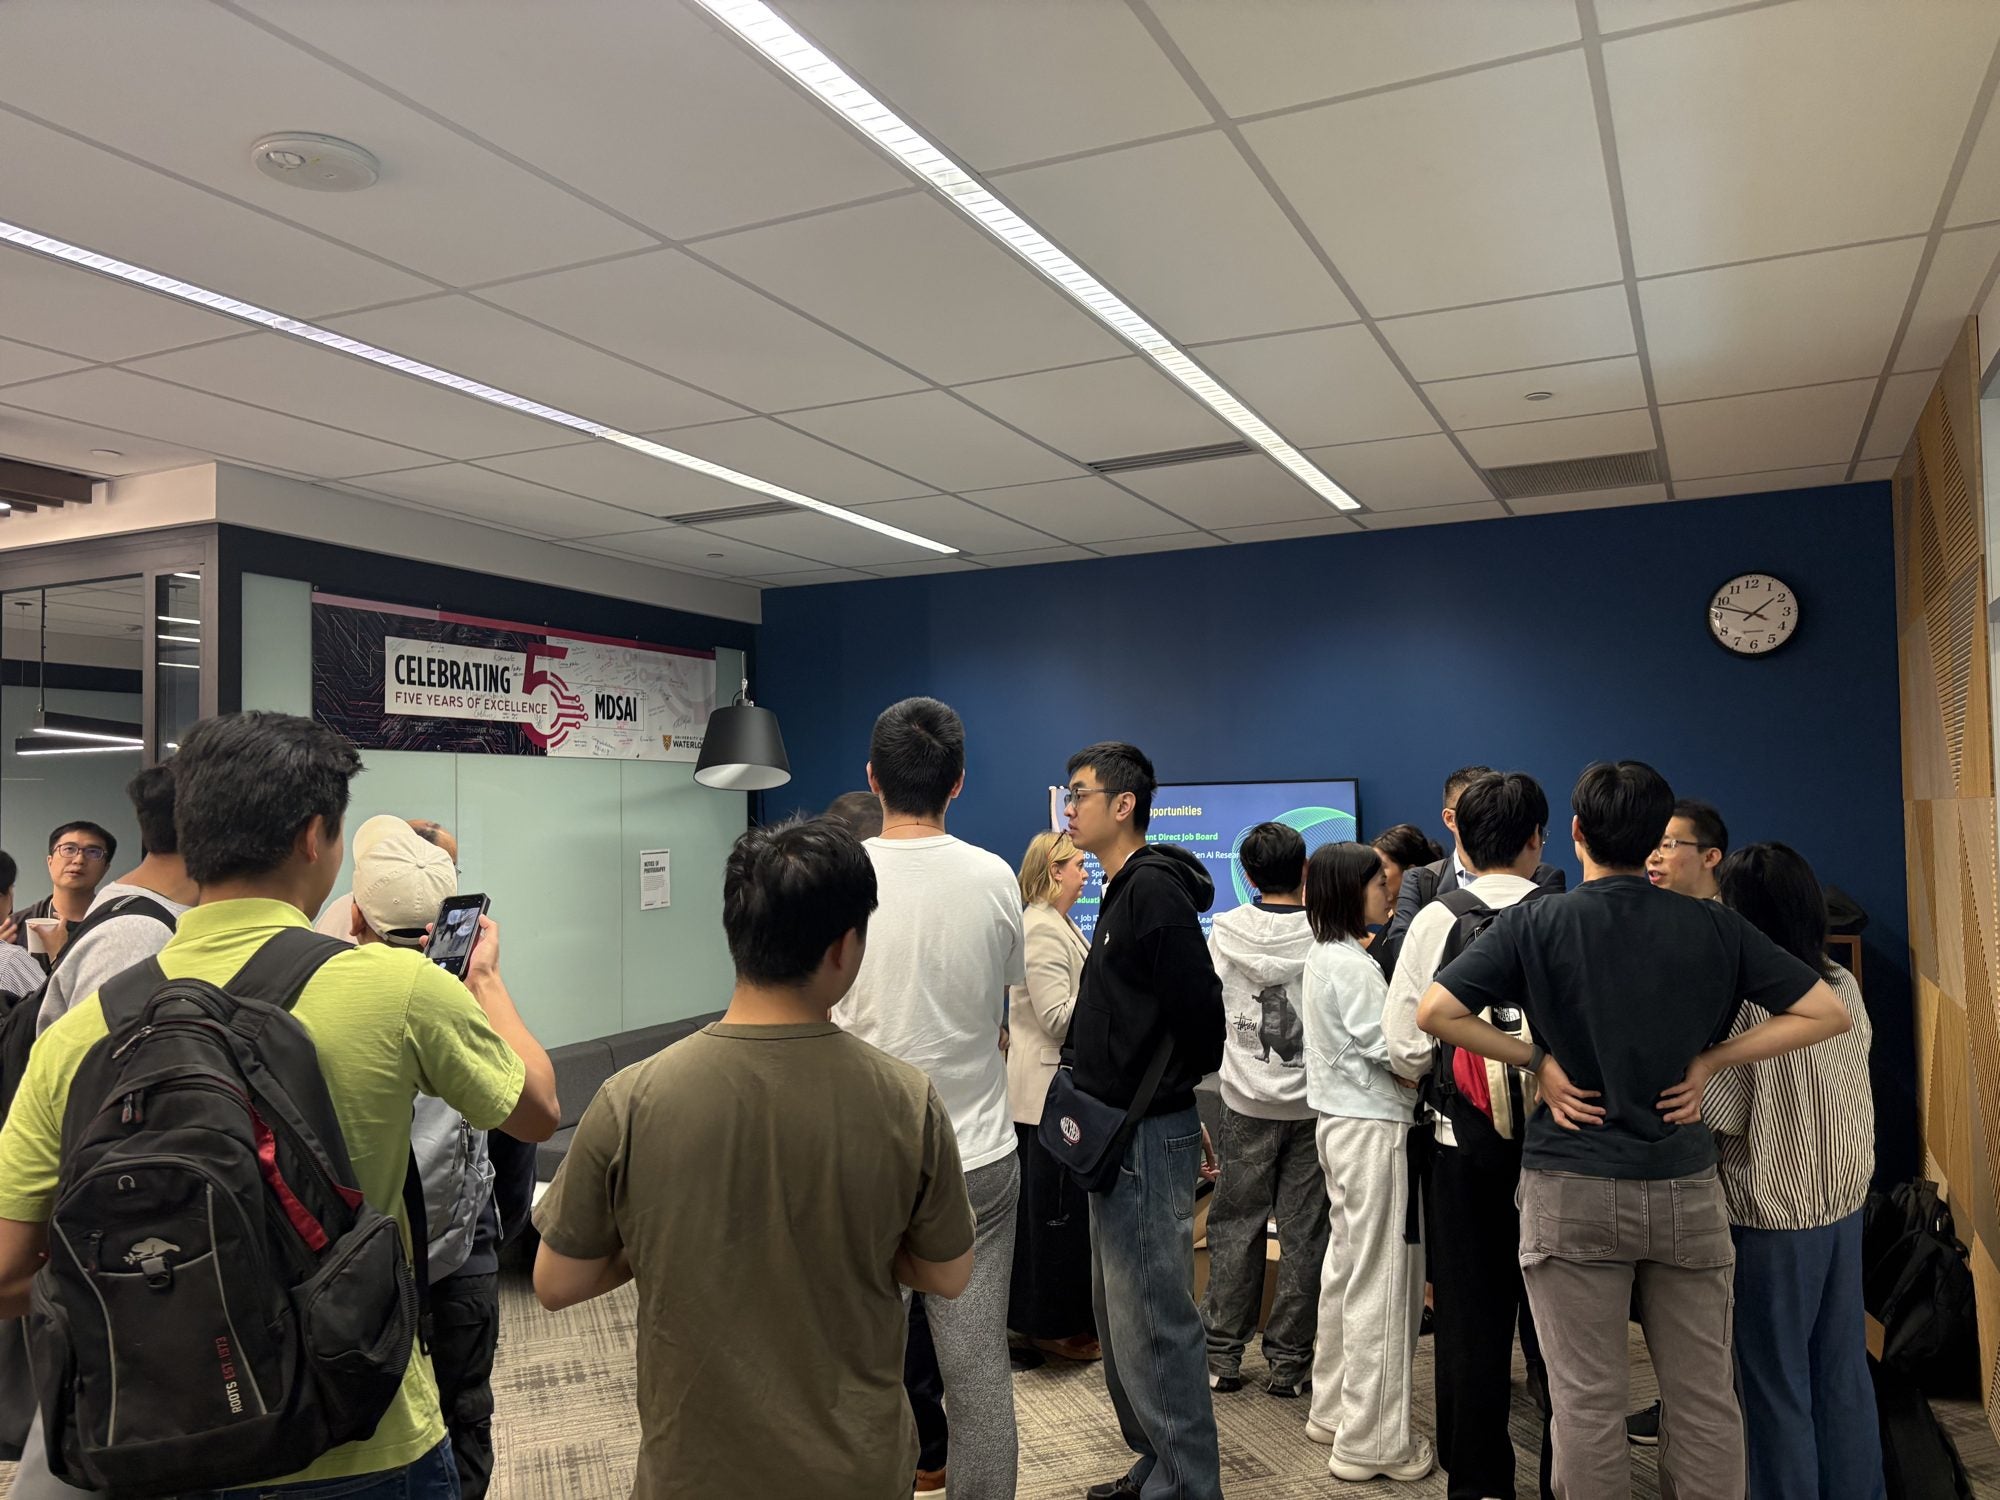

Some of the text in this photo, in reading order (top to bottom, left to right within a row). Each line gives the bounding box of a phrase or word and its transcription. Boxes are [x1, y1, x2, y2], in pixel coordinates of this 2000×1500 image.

[1745, 579, 1759, 589] 12
[1767, 582, 1772, 592] 1
[1729, 585, 1741, 595] 11
[1717, 596, 1730, 606] 10
[1776, 593, 1786, 603] 2
[1714, 611, 1723, 620] 9
[1782, 606, 1791, 616] 3
[1777, 621, 1785, 631] 4
[1719, 627, 1728, 636] 8
[1733, 636, 1742, 646] 7
[1767, 633, 1776, 643] 5
[1749, 640, 1758, 649] 6
[394, 654, 511, 694] CELEBRATING
[395, 691, 423, 705] FIVE
[426, 694, 463, 708] YEARS
[467, 697, 481, 709] OF
[484, 699, 548, 715] EXCELLENCE
[595, 693, 637, 722] MDSAI
[673, 740, 703, 749] WATERLO
[1149, 805, 1202, 819] pportunities
[1158, 832, 1181, 841] Direct
[1181, 832, 1194, 843] Job
[1195, 832, 1218, 841] Board
[1206, 851, 1213, 859] AI
[1215, 851, 1240, 859] Resear
[1080, 914, 1091, 922] Job
[226, 1381, 243, 1414] ROOTS
